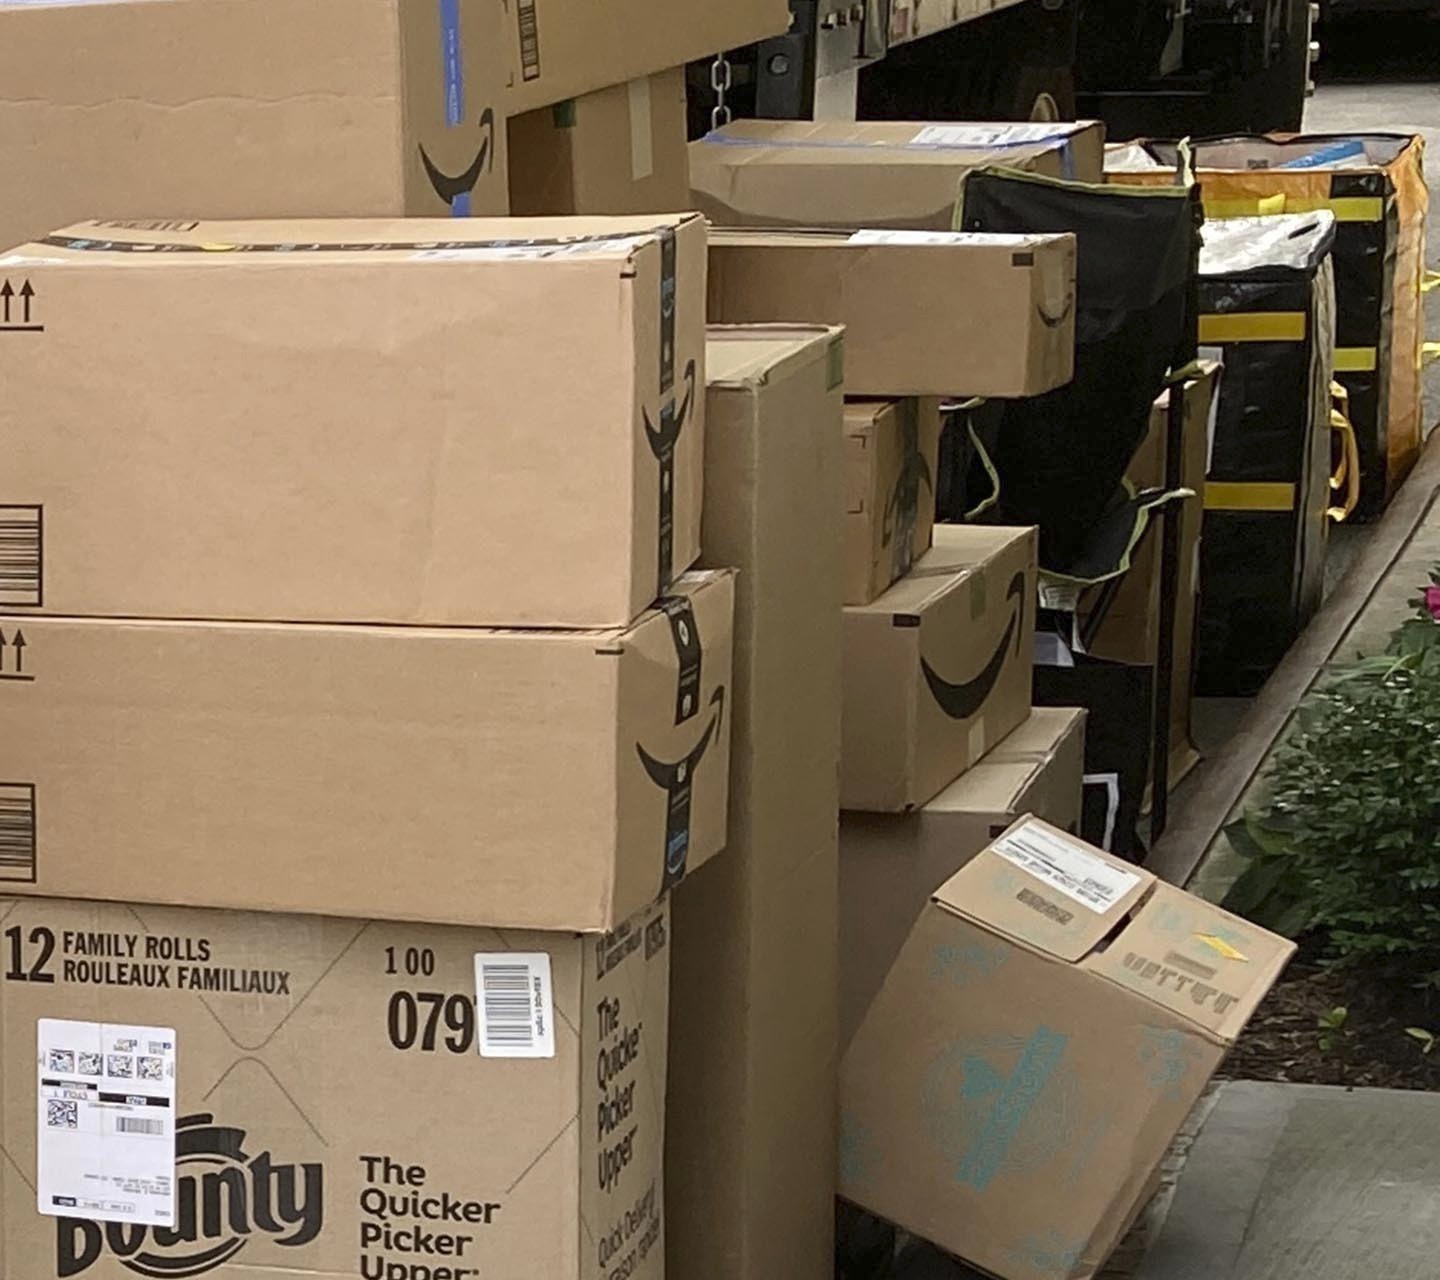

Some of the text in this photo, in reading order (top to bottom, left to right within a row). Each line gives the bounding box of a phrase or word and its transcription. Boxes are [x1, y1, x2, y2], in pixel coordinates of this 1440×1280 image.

[4, 925, 56, 984] 12
[62, 929, 140, 960] FAMILY
[144, 935, 212, 962] ROLLS
[383, 946, 436, 977] 1 00
[62, 959, 292, 996] ROULEAUX FAMILIAUX
[387, 990, 479, 1055] 079
[358, 1154, 427, 1187] The
[358, 1187, 502, 1224] Quicker
[359, 1222, 474, 1257] Picker
